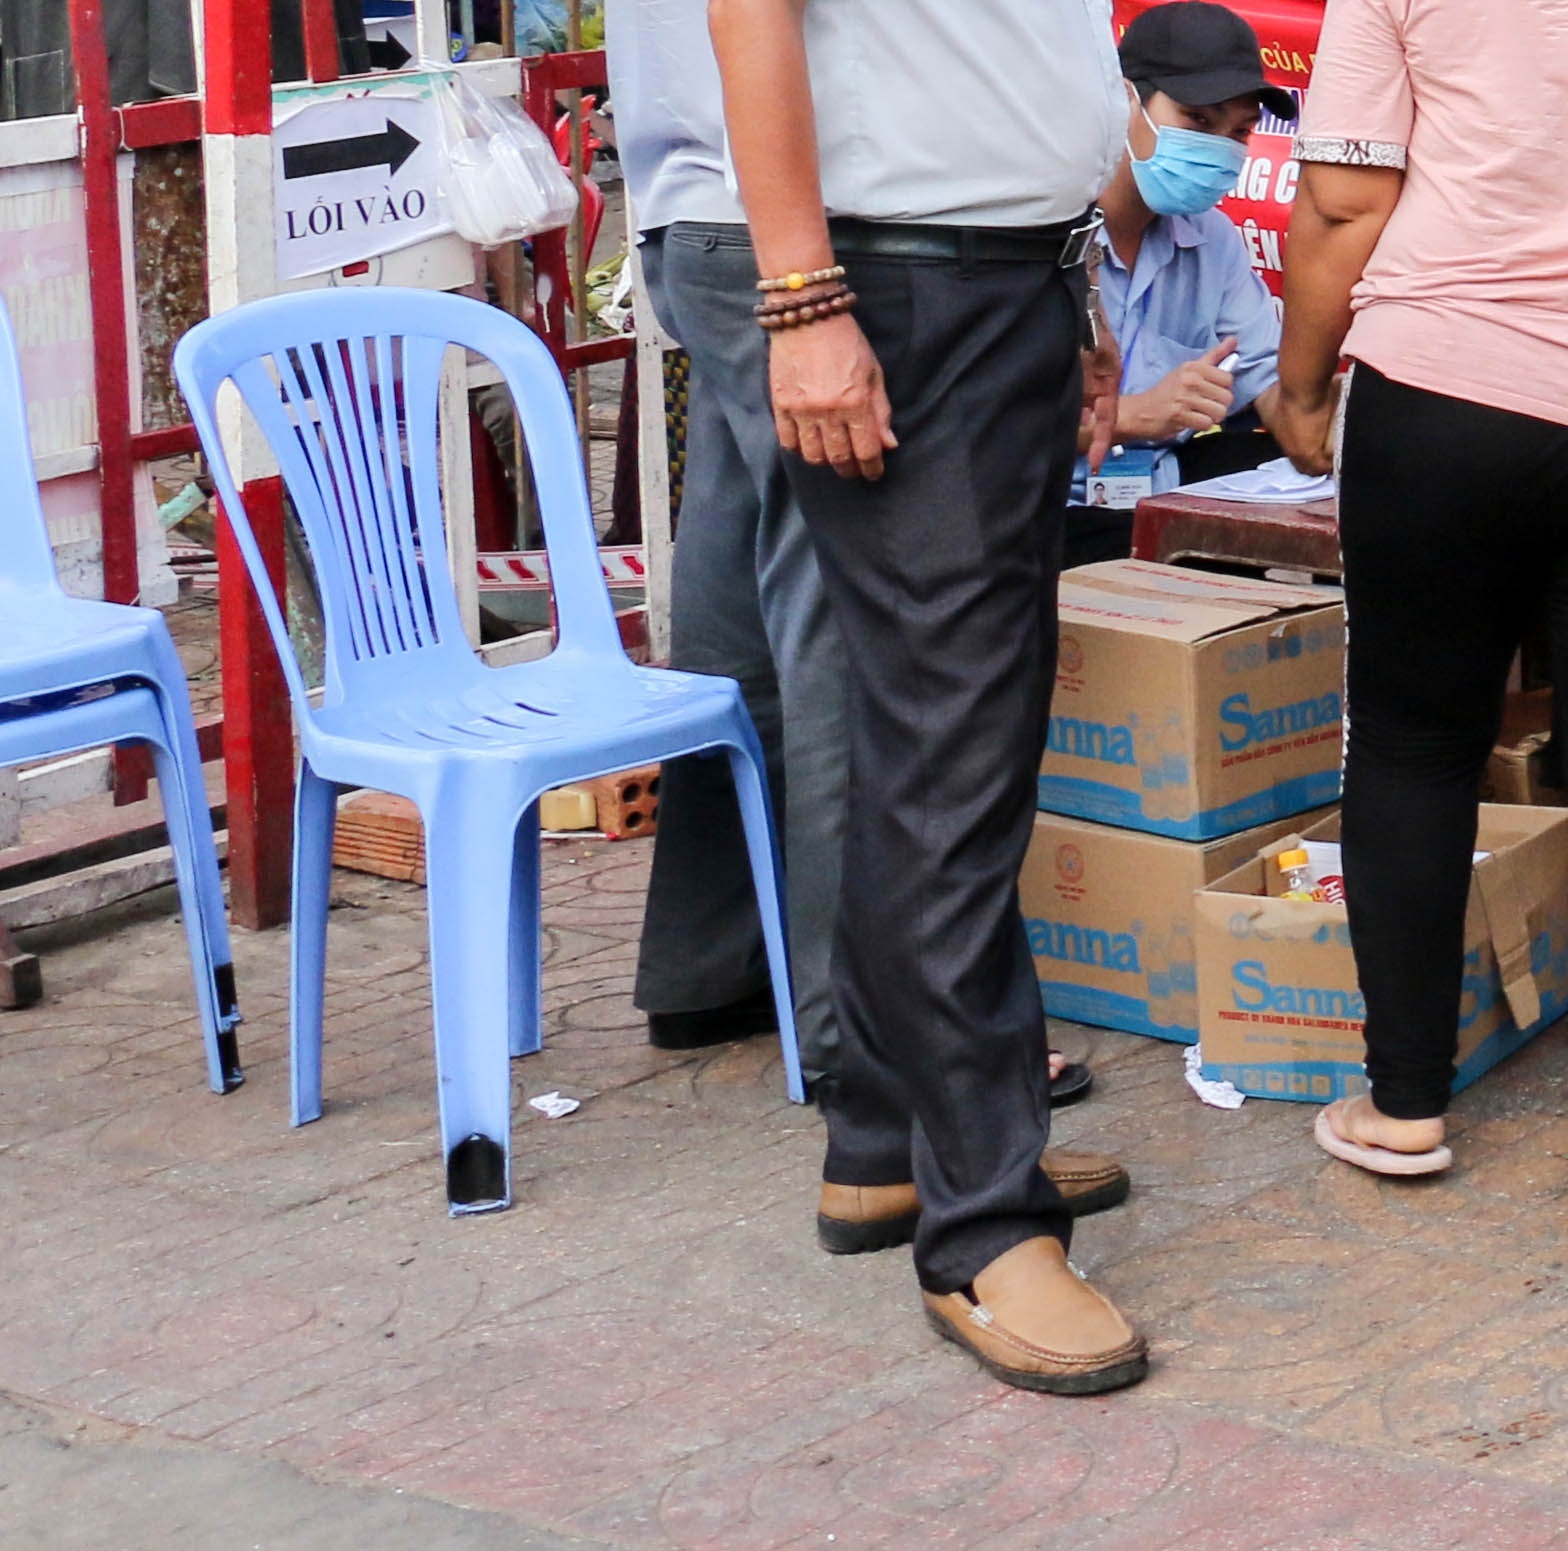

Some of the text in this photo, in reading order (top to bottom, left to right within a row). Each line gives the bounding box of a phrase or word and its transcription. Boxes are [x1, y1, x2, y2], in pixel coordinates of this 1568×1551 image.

[1260, 41, 1310, 75] CỦA
[285, 185, 426, 240] LỐI VÀO
[1219, 693, 1342, 752] Sanna
[1024, 918, 1142, 973] anna
